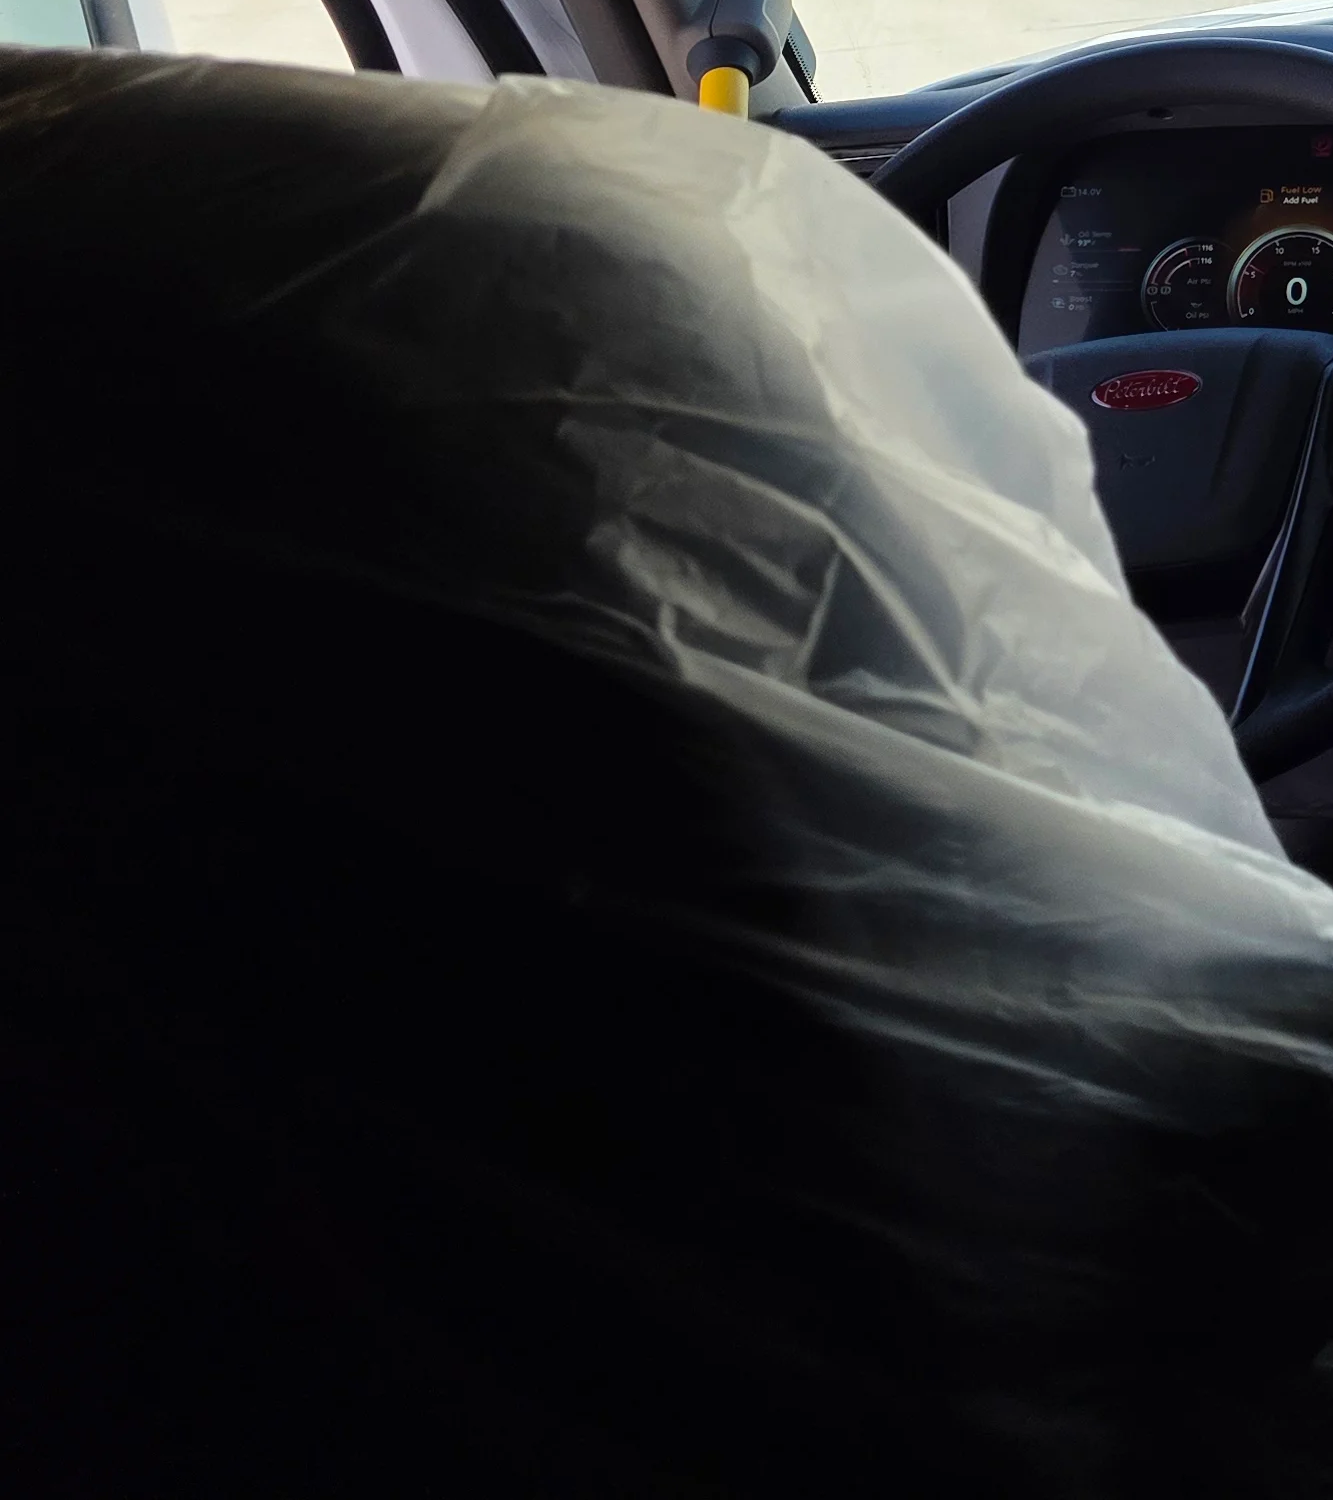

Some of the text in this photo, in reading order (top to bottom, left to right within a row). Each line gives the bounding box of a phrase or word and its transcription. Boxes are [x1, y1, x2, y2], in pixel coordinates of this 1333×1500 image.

[1078, 188, 1102, 197] 14.0V
[1281, 186, 1323, 194] Fuel Low
[1283, 196, 1319, 204] Add Fuel
[1201, 244, 1214, 252] 116
[1275, 247, 1285, 255] 10
[1311, 247, 1321, 255] 15
[1201, 257, 1213, 265] 116
[1250, 271, 1256, 279] 5
[1286, 277, 1308, 306] 0
[1248, 307, 1255, 315] 0
[1185, 311, 1197, 320] Oil
[1103, 375, 1187, 403] Peterbilt
